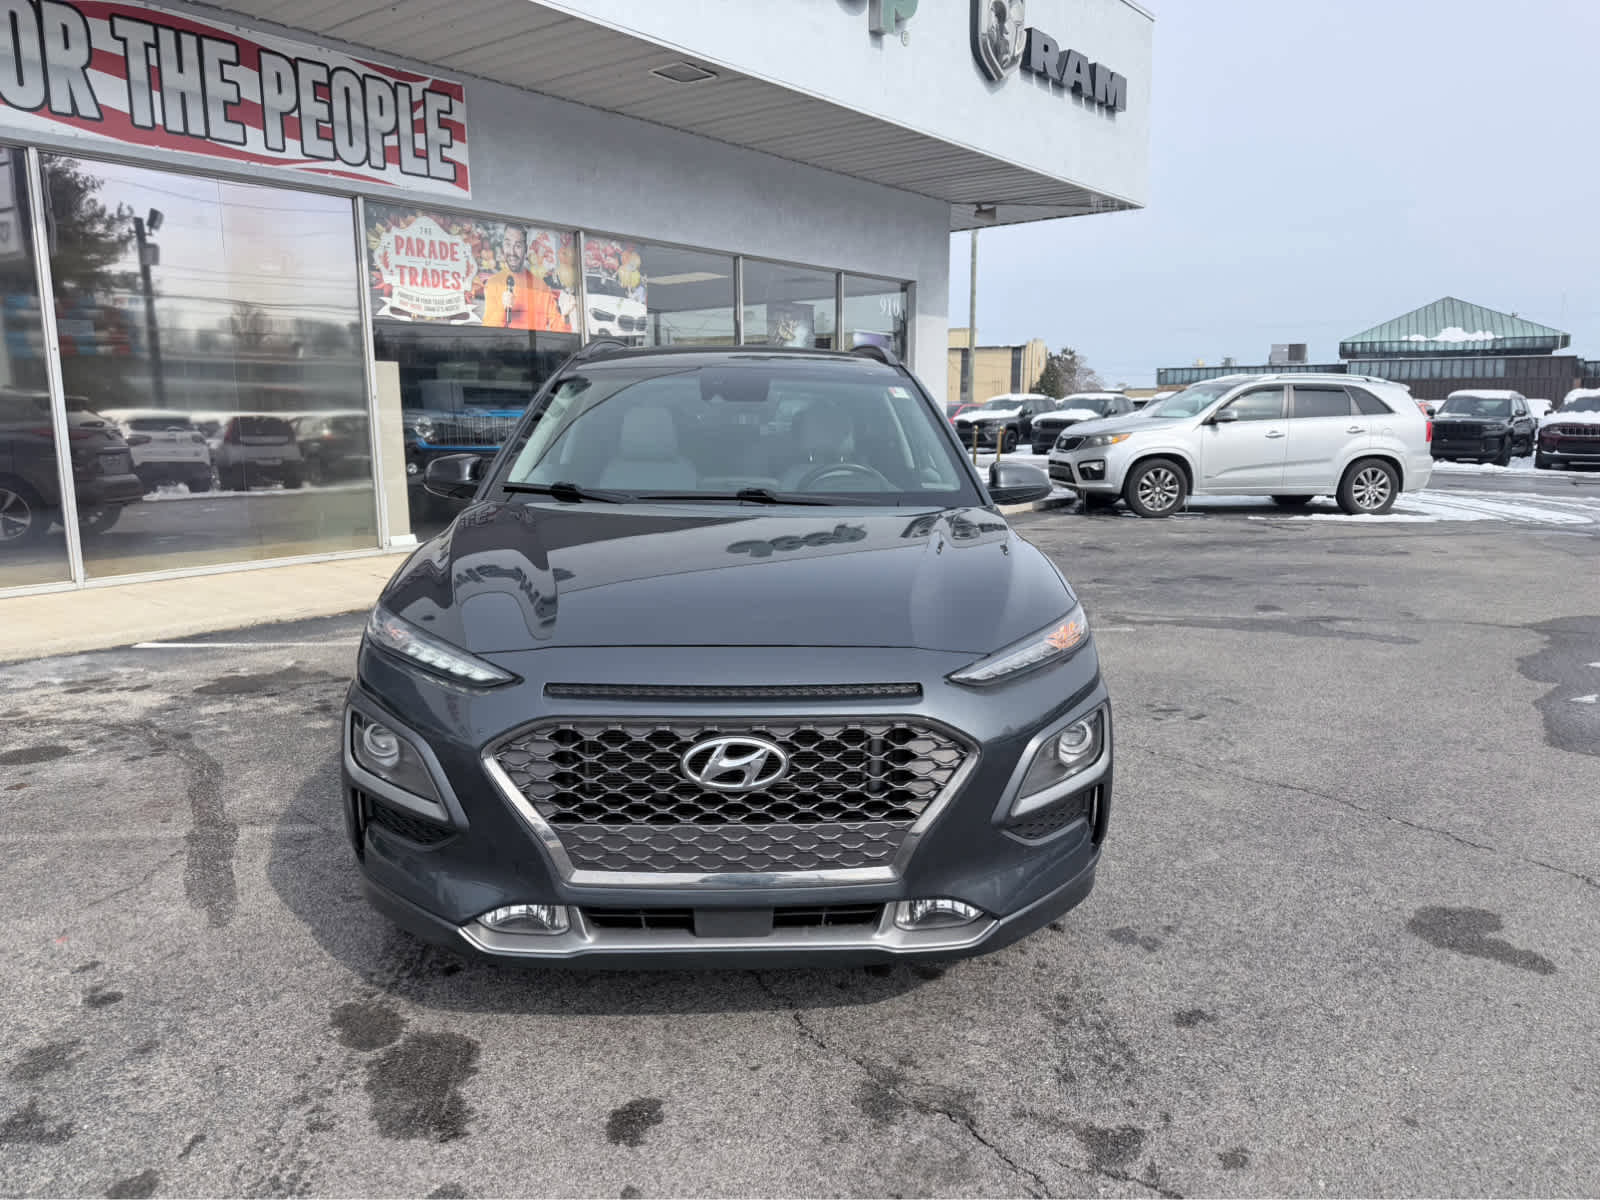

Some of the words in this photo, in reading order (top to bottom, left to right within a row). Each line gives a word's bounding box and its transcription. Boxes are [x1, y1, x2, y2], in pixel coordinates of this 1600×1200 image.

[1020, 27, 1127, 112] RAM
[110, 14, 247, 146] THE
[258, 48, 457, 182] PEOPLE
[394, 235, 460, 262] PARADE
[395, 264, 462, 290] TRADES
